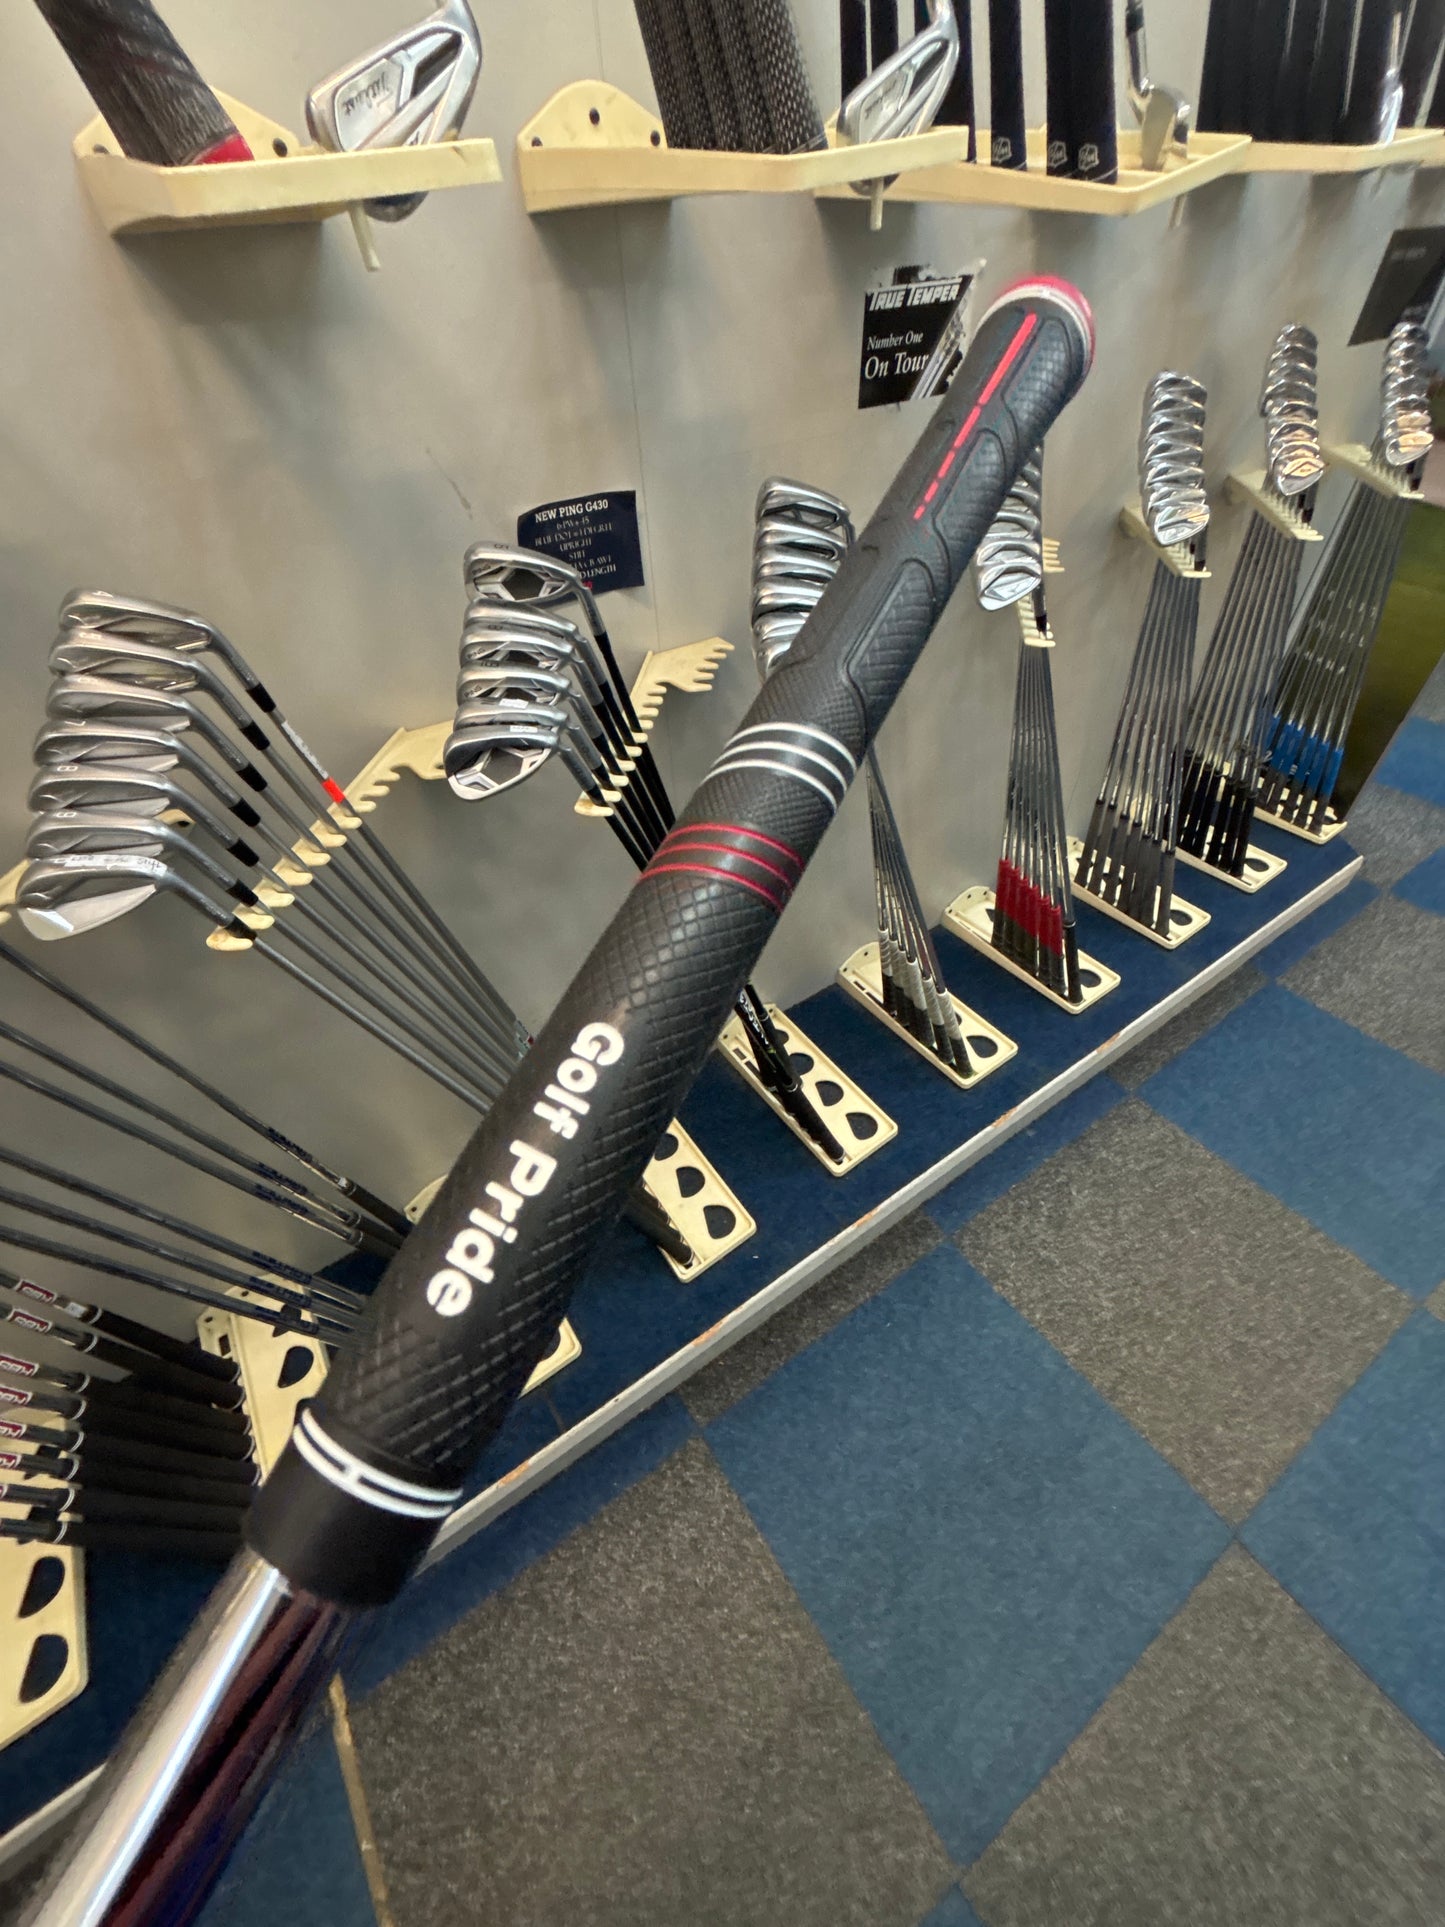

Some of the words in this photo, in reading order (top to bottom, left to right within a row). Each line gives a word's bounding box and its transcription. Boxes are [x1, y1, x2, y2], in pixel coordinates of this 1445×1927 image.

[867, 285, 908, 311] TRUE
[905, 277, 962, 307] TEMPER
[866, 333, 903, 351] Number
[905, 330, 924, 345] One
[864, 355, 889, 380] On
[894, 351, 930, 376] Tour
[535, 509, 558, 523] NEW
[559, 503, 584, 517] PING
[585, 499, 609, 512] G430
[533, 1022, 625, 1140] Golf
[426, 1139, 558, 1317] Pride
